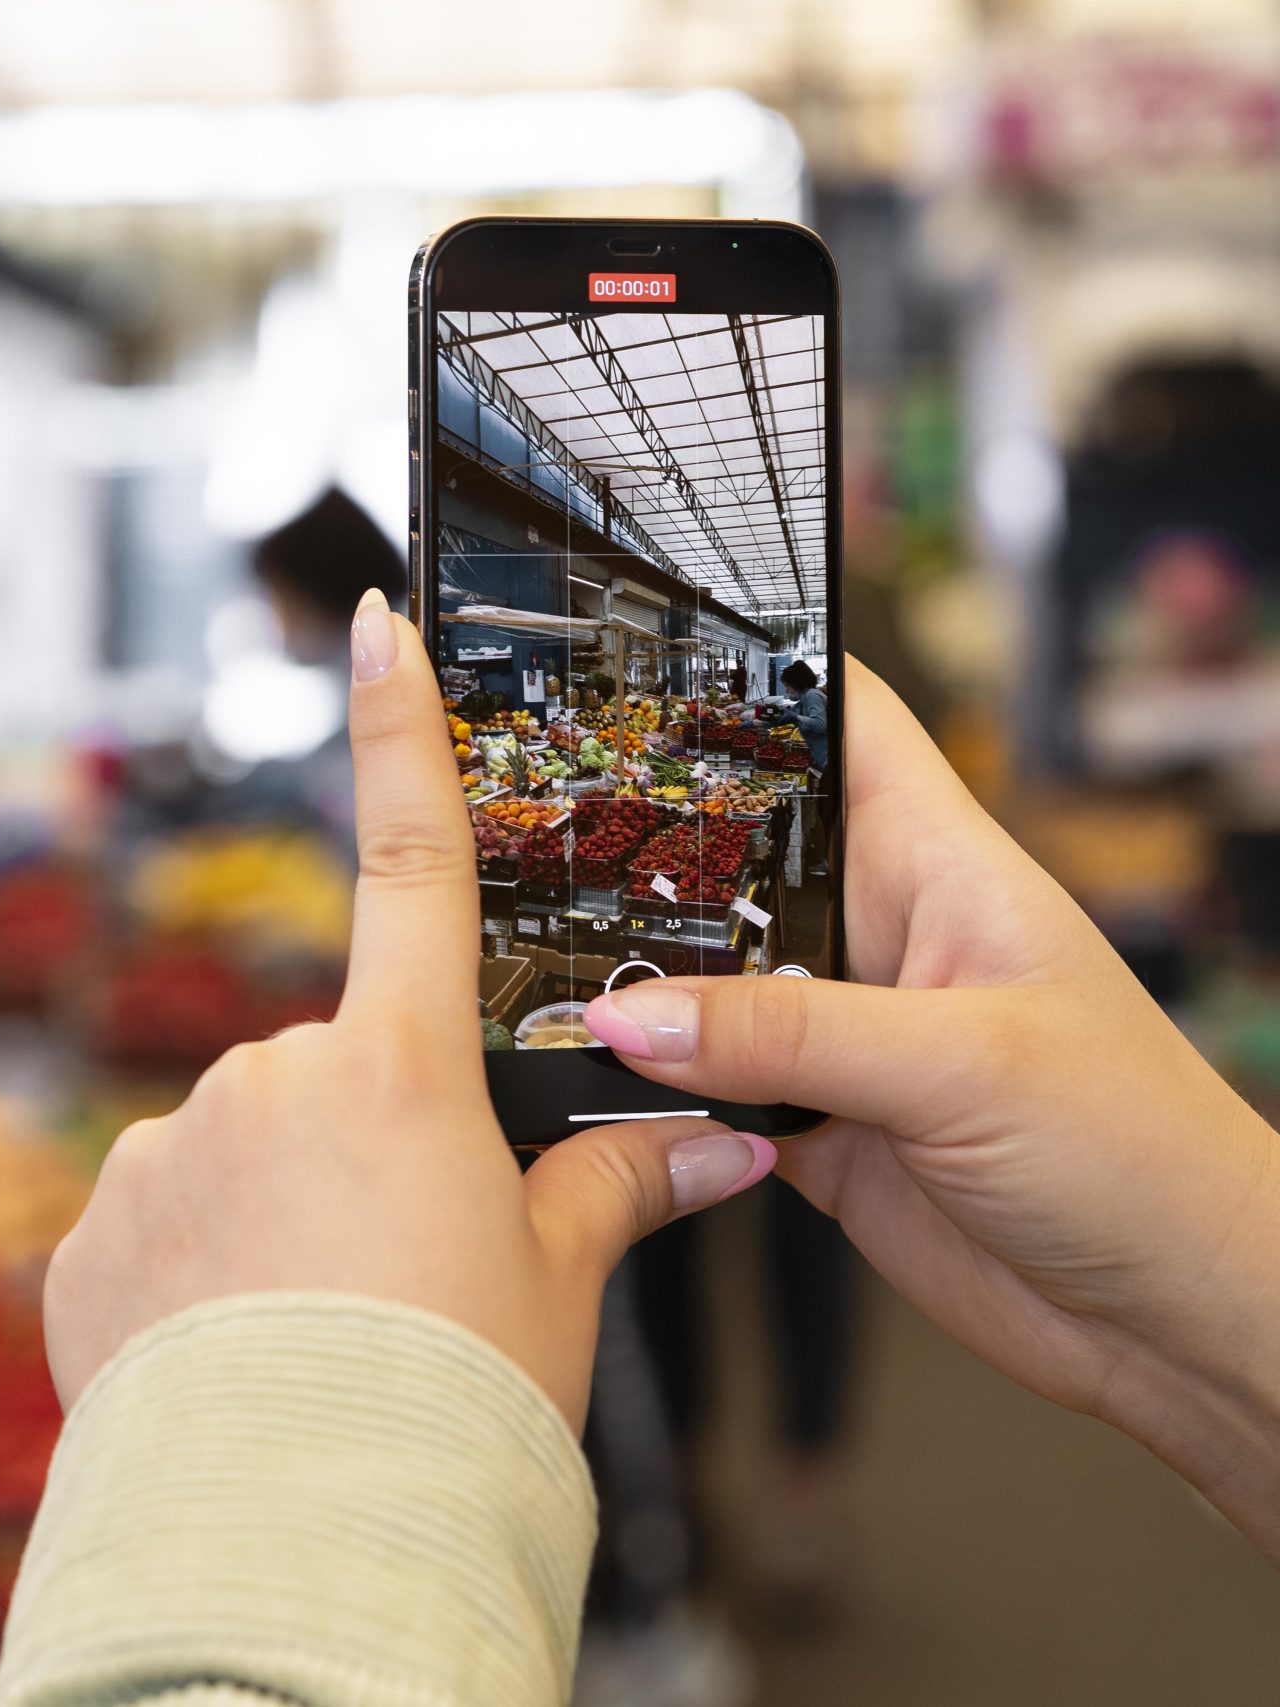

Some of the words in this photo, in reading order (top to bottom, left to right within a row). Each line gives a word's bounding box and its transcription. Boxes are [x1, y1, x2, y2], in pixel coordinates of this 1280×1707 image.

[594, 280, 669, 296] 00:00:01
[593, 921, 609, 931] 0,5
[666, 919, 681, 930] 2,5
